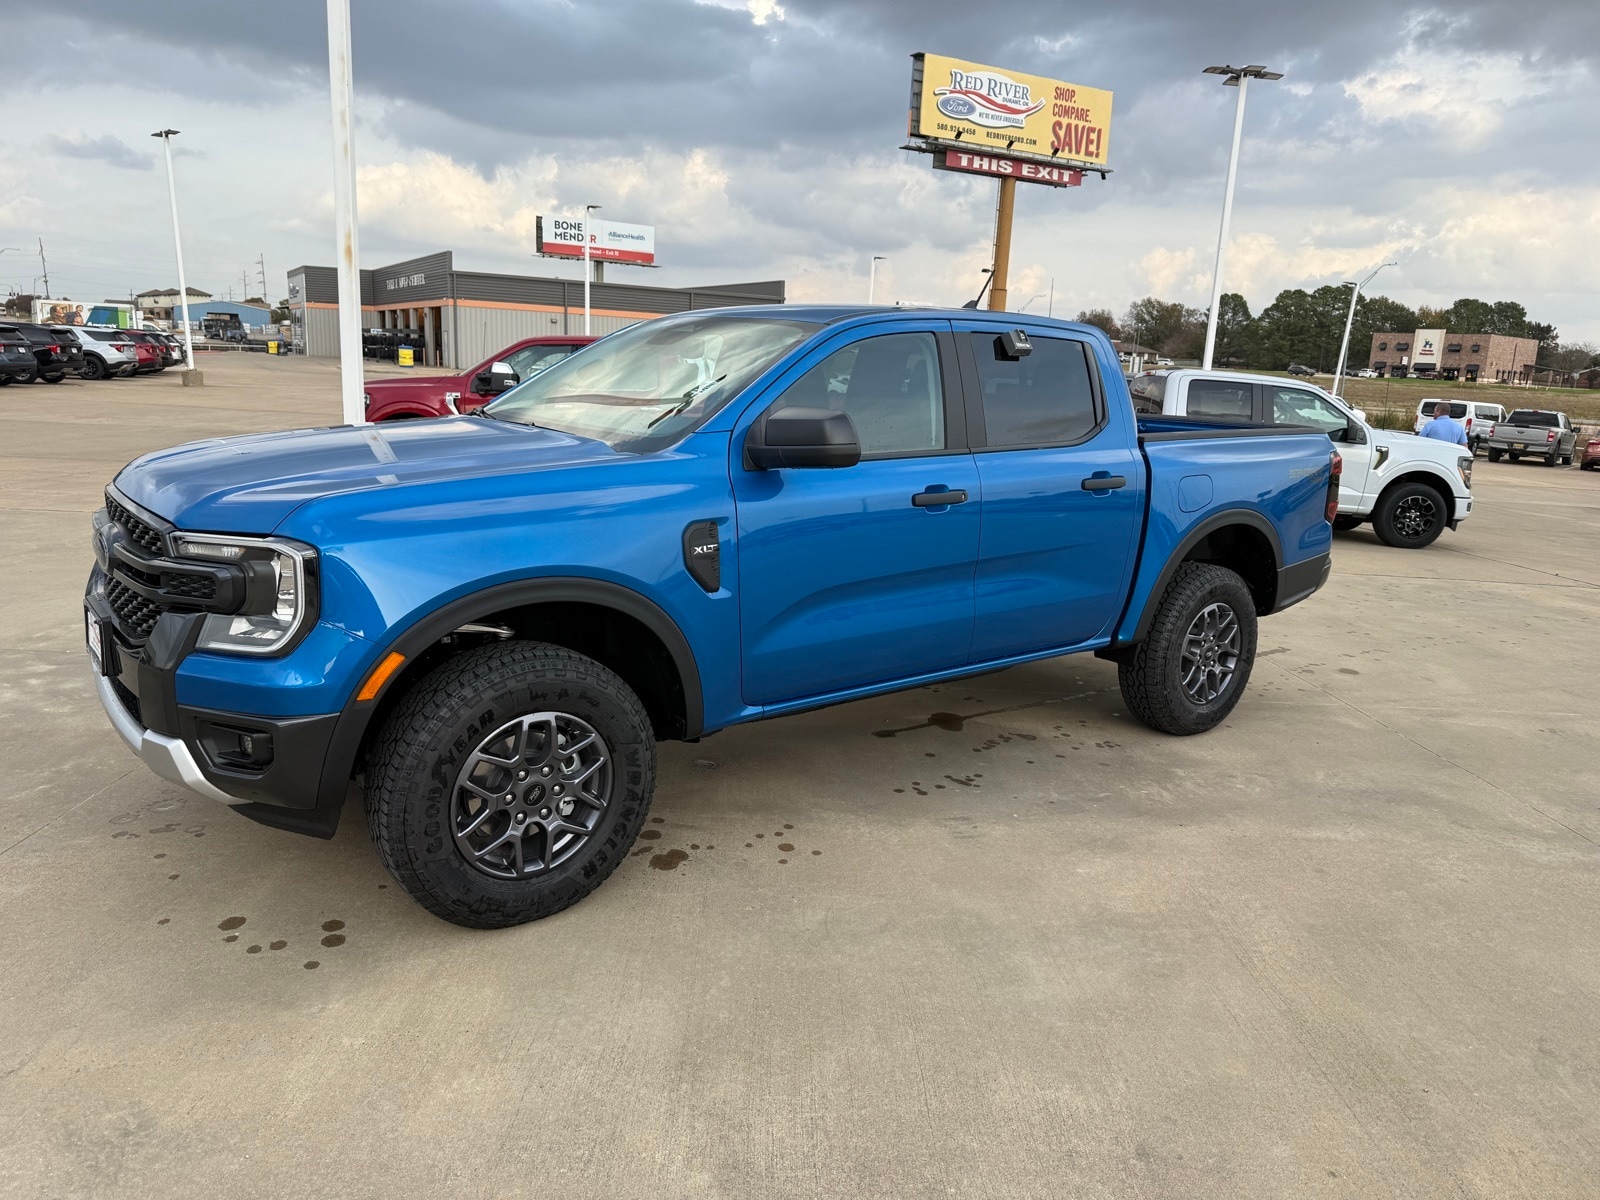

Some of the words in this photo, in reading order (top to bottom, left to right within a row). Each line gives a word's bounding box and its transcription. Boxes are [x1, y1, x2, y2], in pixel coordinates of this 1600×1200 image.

[952, 71, 983, 91] RED
[987, 78, 1030, 101] RIVER
[1054, 86, 1076, 103] SHOP.
[947, 98, 968, 113] Ford
[1052, 103, 1092, 123] COMPARE.
[1051, 120, 1102, 158] SAVE!
[957, 153, 1013, 174] THIS
[1021, 163, 1074, 182] EXIT
[554, 220, 583, 232] BONE
[554, 231, 597, 244] MENDR
[693, 544, 718, 555] XLT
[581, 748, 642, 879] WRANGLER
